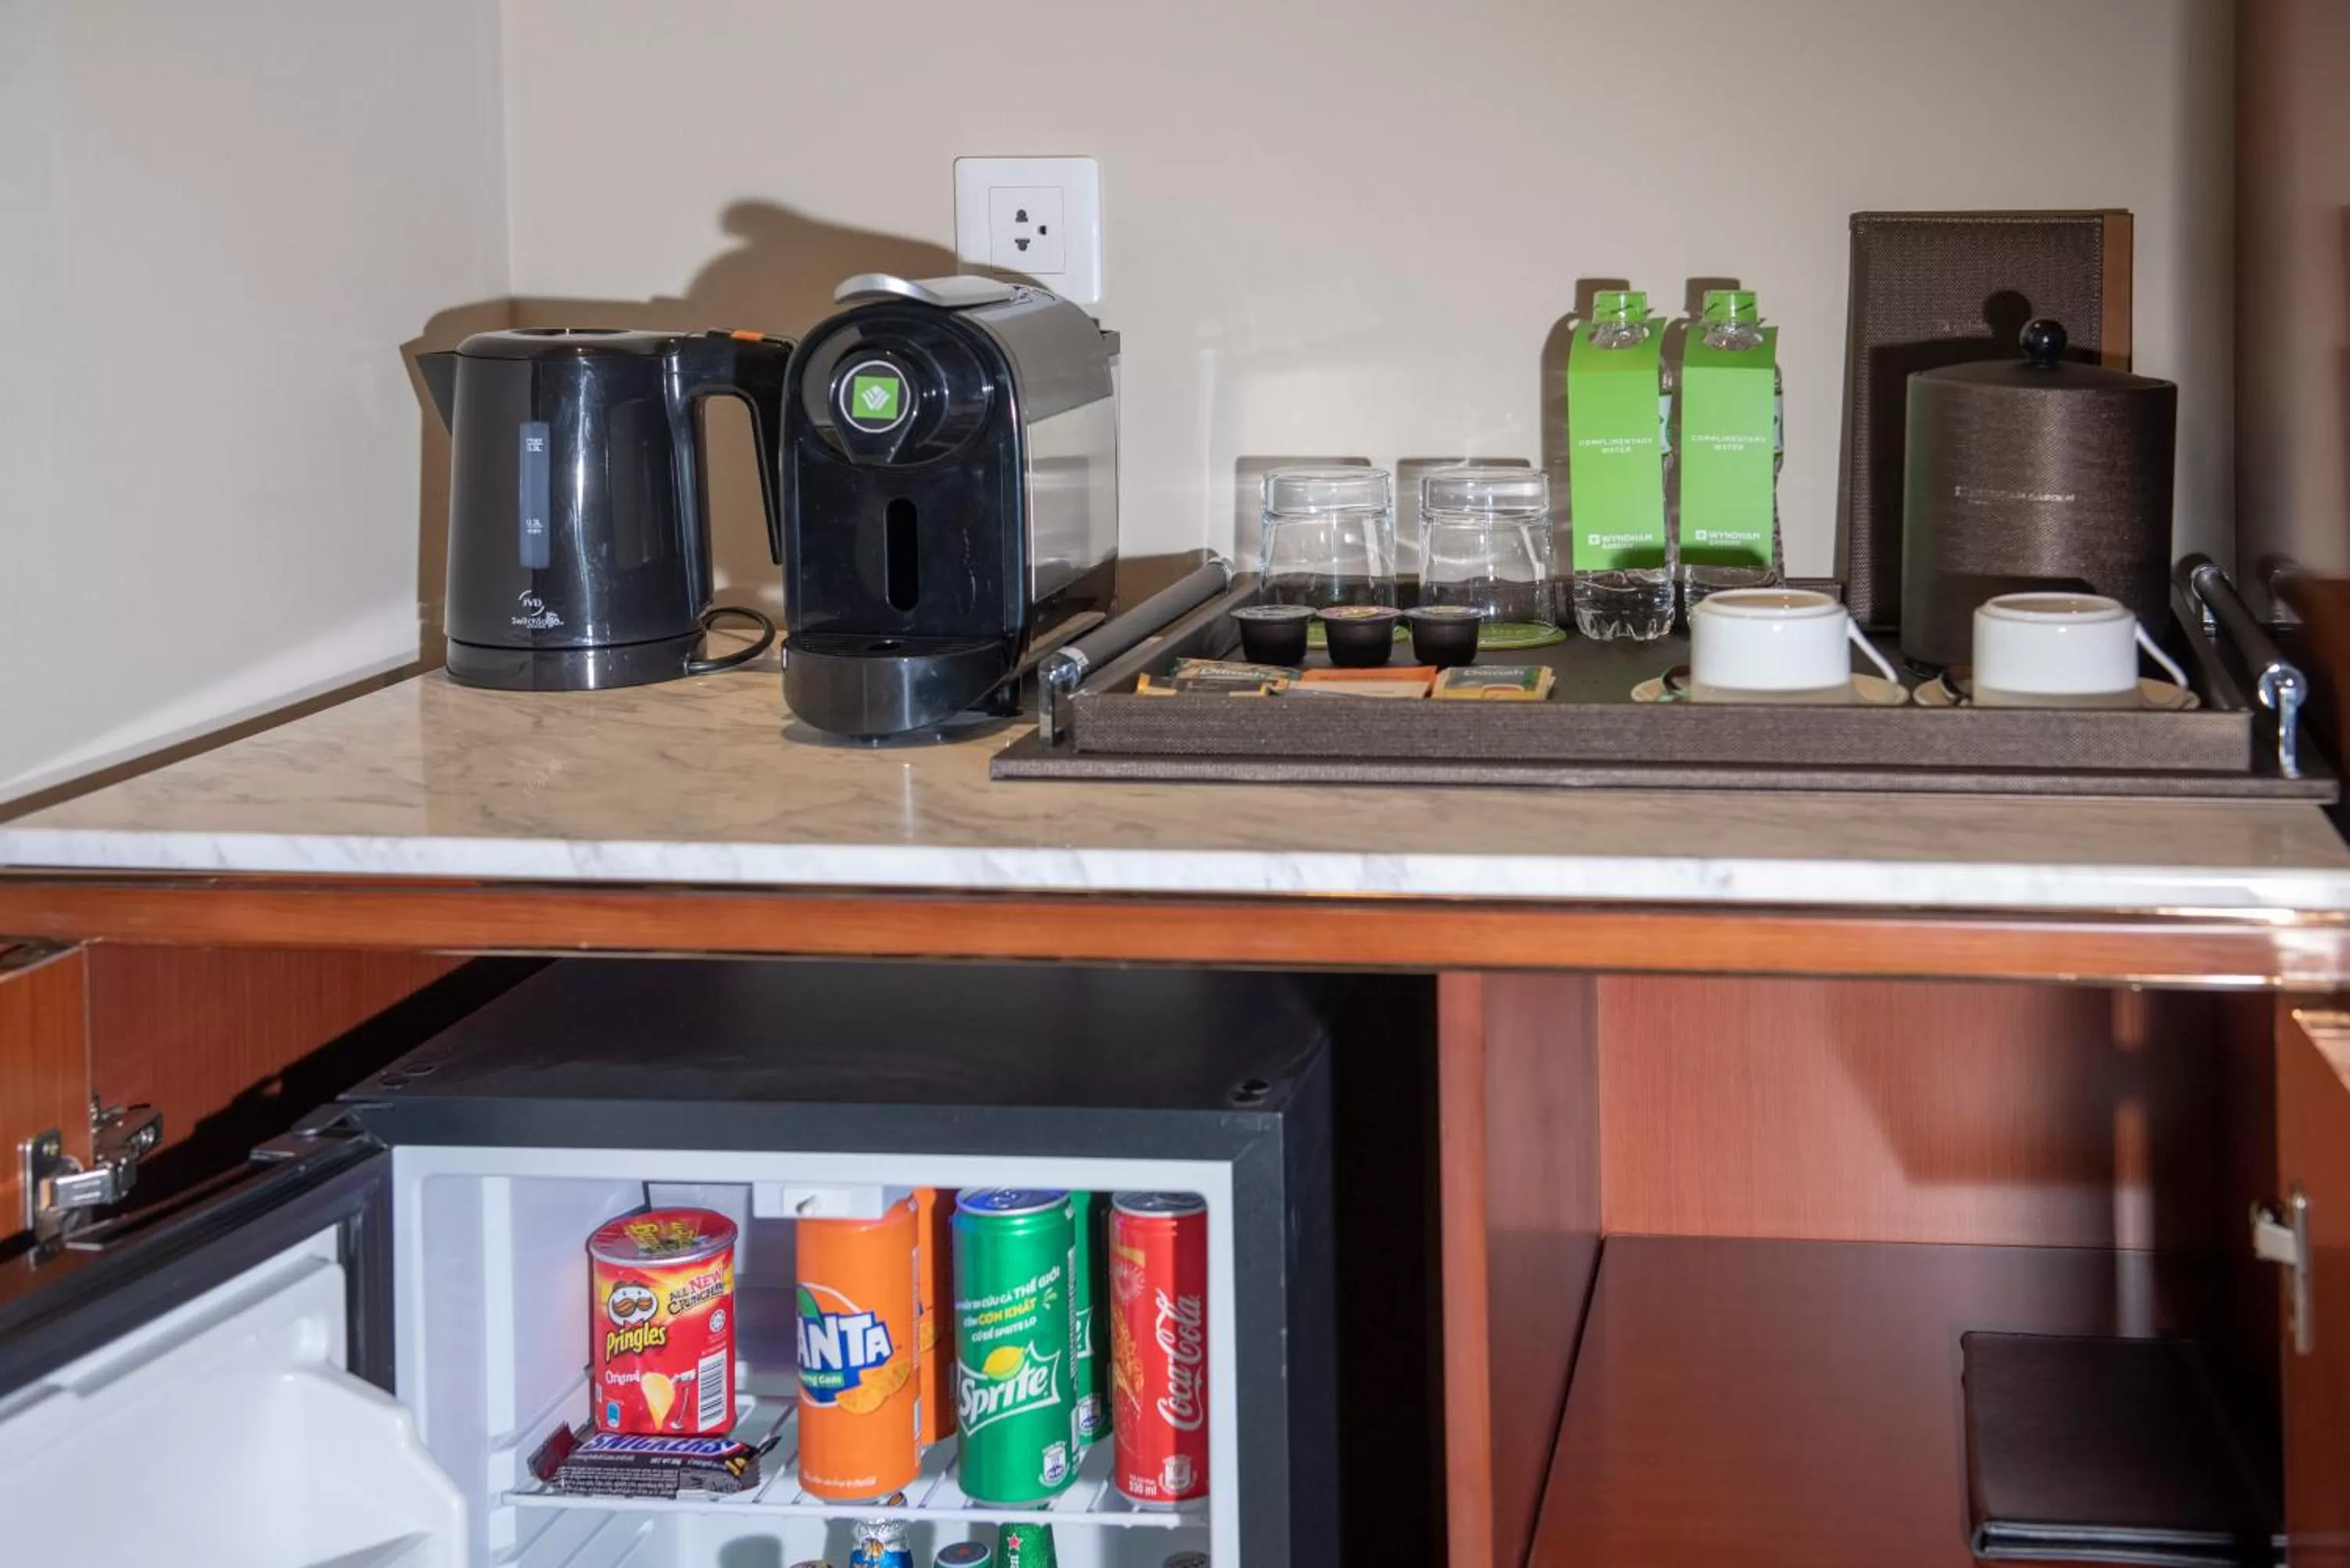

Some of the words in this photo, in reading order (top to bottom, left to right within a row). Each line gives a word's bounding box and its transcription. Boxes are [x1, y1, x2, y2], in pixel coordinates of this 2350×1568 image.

[1602, 533, 1654, 543] WYNDHAM
[1708, 530, 1761, 540] WYNDHAM
[689, 1266, 724, 1294] NEW
[605, 1321, 667, 1364] Pringles
[797, 1314, 891, 1370] ANTA
[606, 1369, 641, 1386] Original
[959, 1360, 1049, 1425] Sprite
